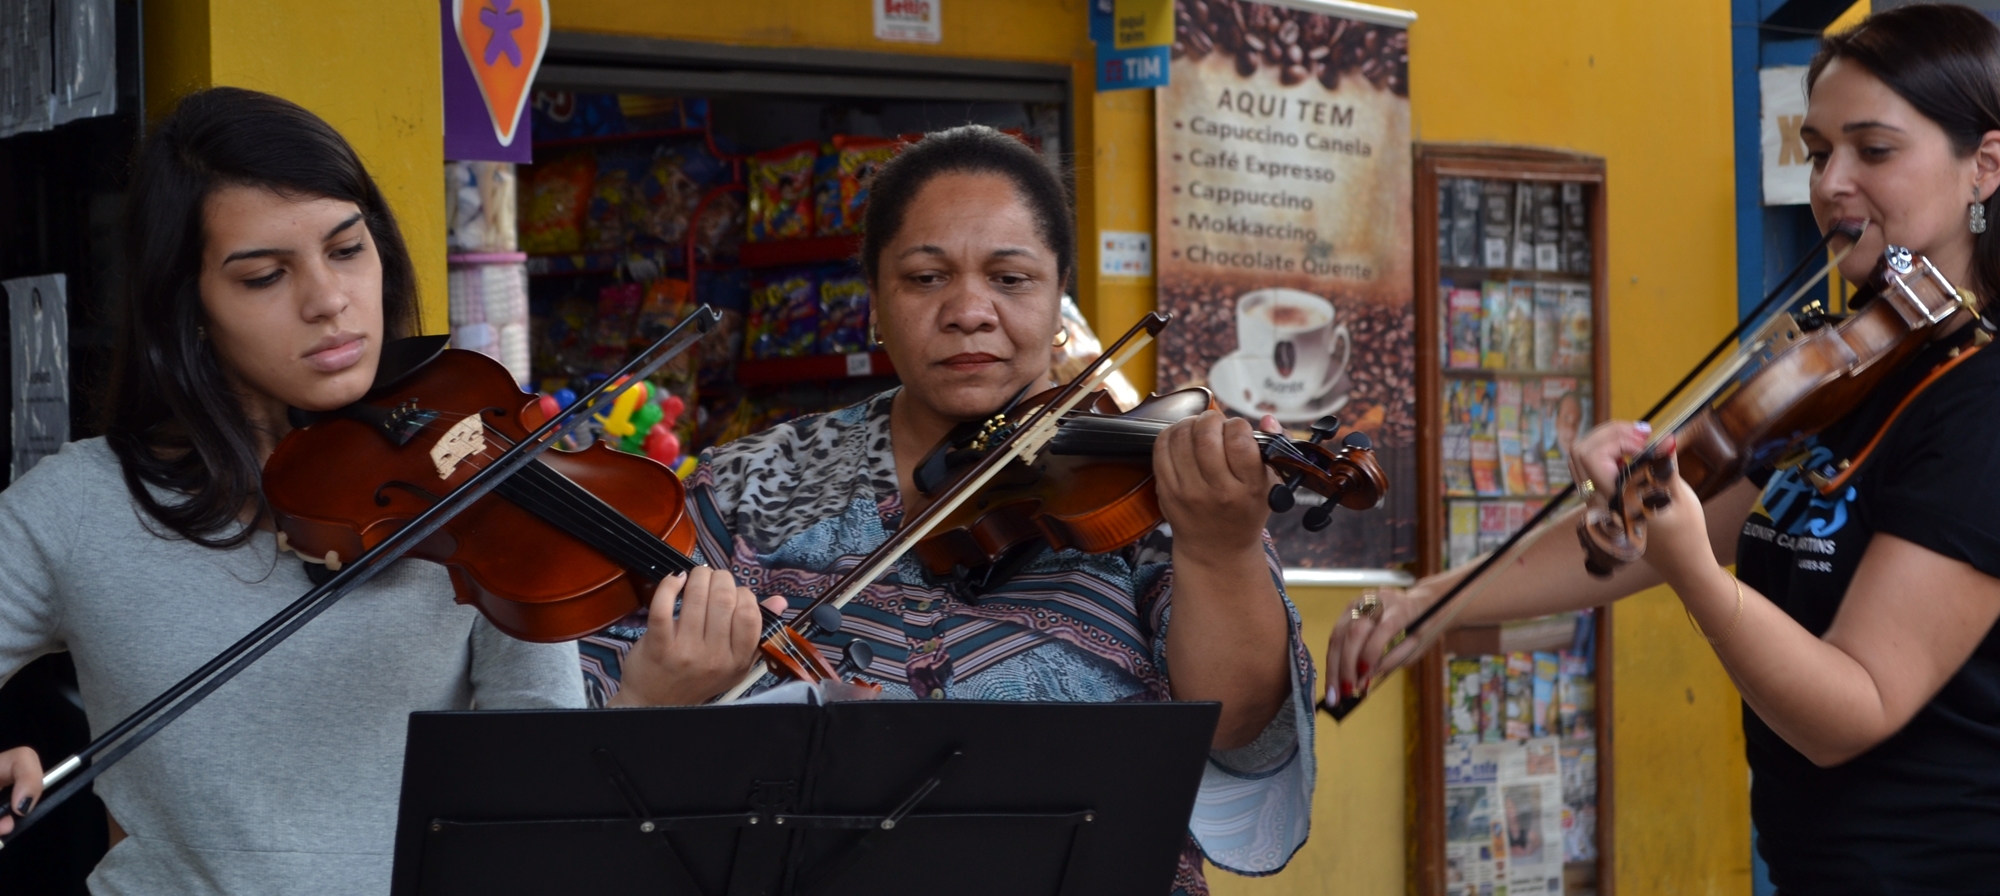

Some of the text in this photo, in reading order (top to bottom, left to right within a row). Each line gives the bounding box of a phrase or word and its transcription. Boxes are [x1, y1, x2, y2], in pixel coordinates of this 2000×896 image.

[1124, 56, 1161, 80] TIM
[1217, 87, 1354, 128] AQUI TEM
[1189, 116, 1372, 157] Capuccino Canela
[1777, 115, 1814, 166] X
[1189, 147, 1335, 184] Café Expresso
[1188, 181, 1314, 211] Cappuccino
[1187, 213, 1317, 244] Mokkaccino
[1186, 244, 1373, 281] Chocolate Quente
